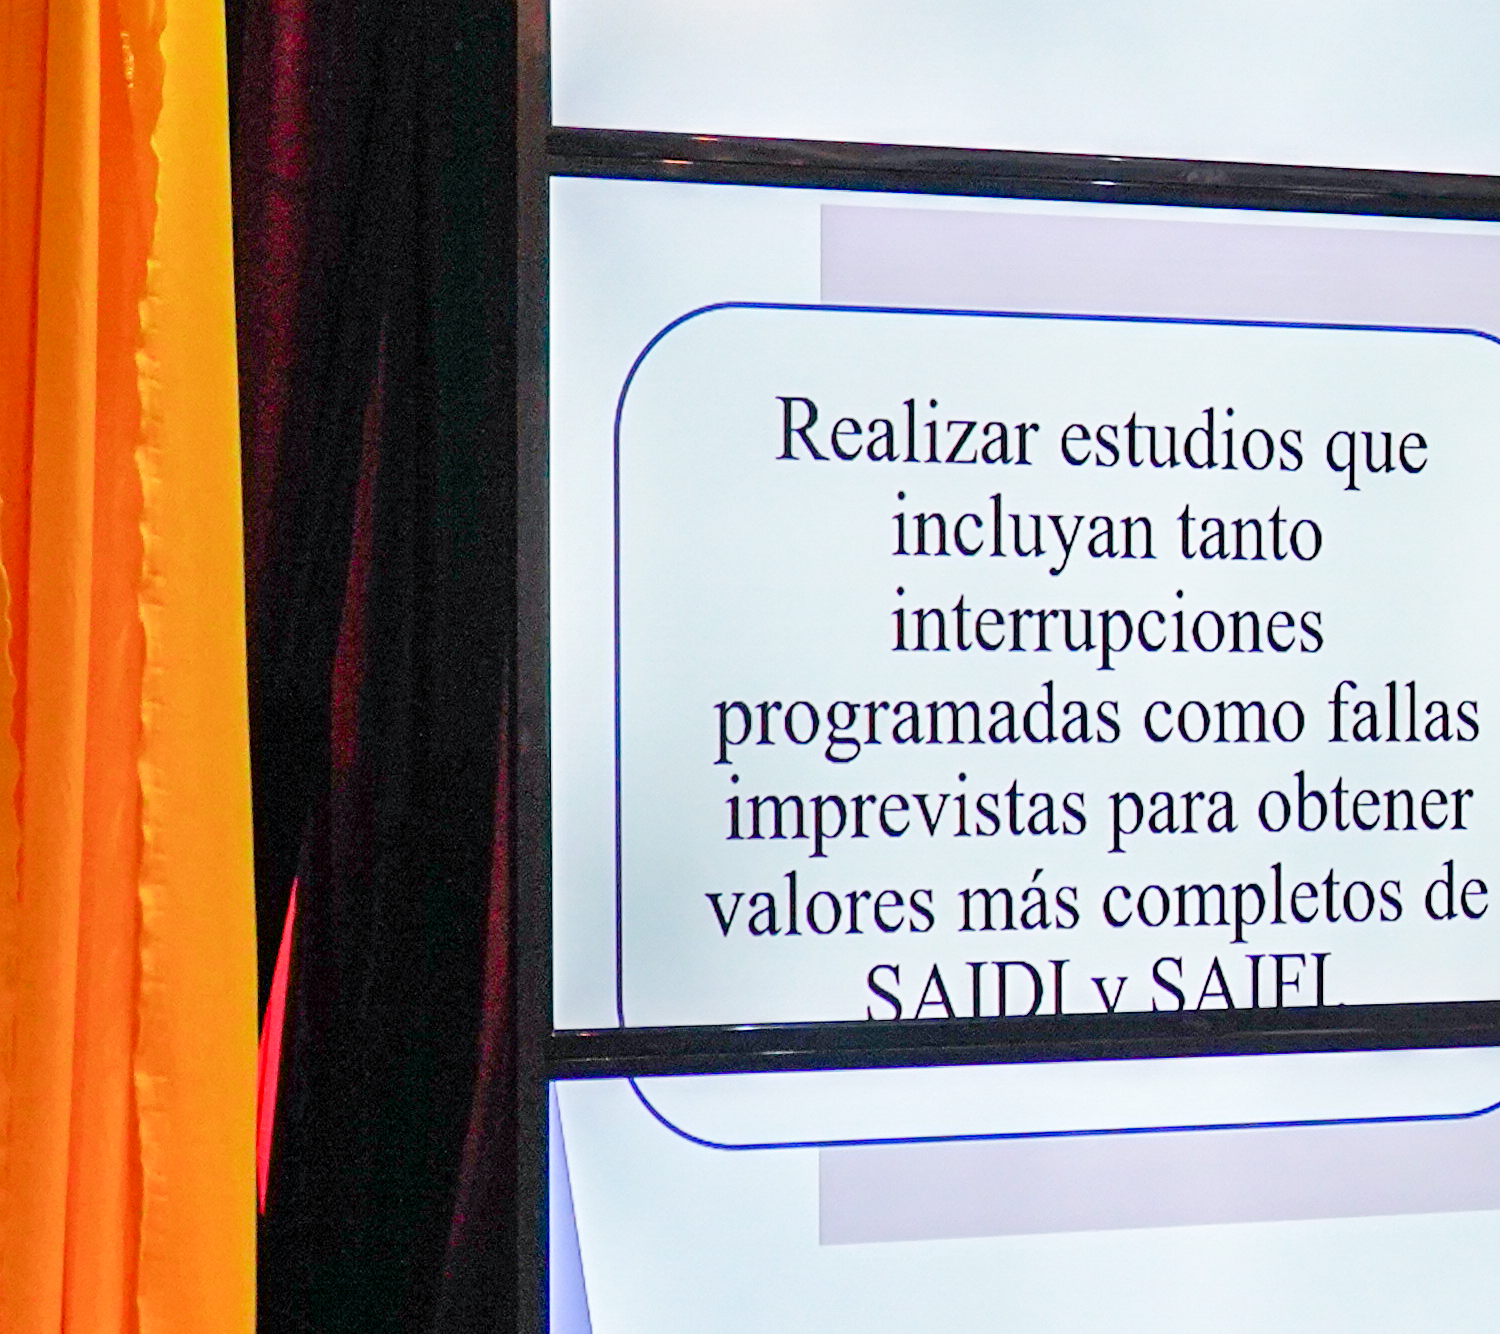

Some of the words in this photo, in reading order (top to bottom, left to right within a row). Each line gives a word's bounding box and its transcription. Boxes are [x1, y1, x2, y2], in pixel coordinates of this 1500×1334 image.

[776, 395, 1040, 465] Realizar
[1061, 408, 1303, 472] estudios
[1327, 424, 1428, 489] que
[892, 491, 1157, 575] incluyan
[1178, 504, 1323, 562] tanto
[891, 587, 1324, 669] interrupciones
[715, 682, 1121, 764] programadas
[1143, 694, 1305, 744] como
[1328, 680, 1481, 744] fallas
[726, 774, 1087, 856] imprevistas
[1109, 790, 1238, 852] para
[1258, 772, 1474, 833] obtener
[706, 872, 935, 936] valores
[958, 870, 1080, 931] más
[1102, 863, 1403, 944] completos
[1426, 862, 1489, 920] de
[867, 959, 1070, 1021] SAIDI
[1152, 952, 1344, 1012] SAIFI
